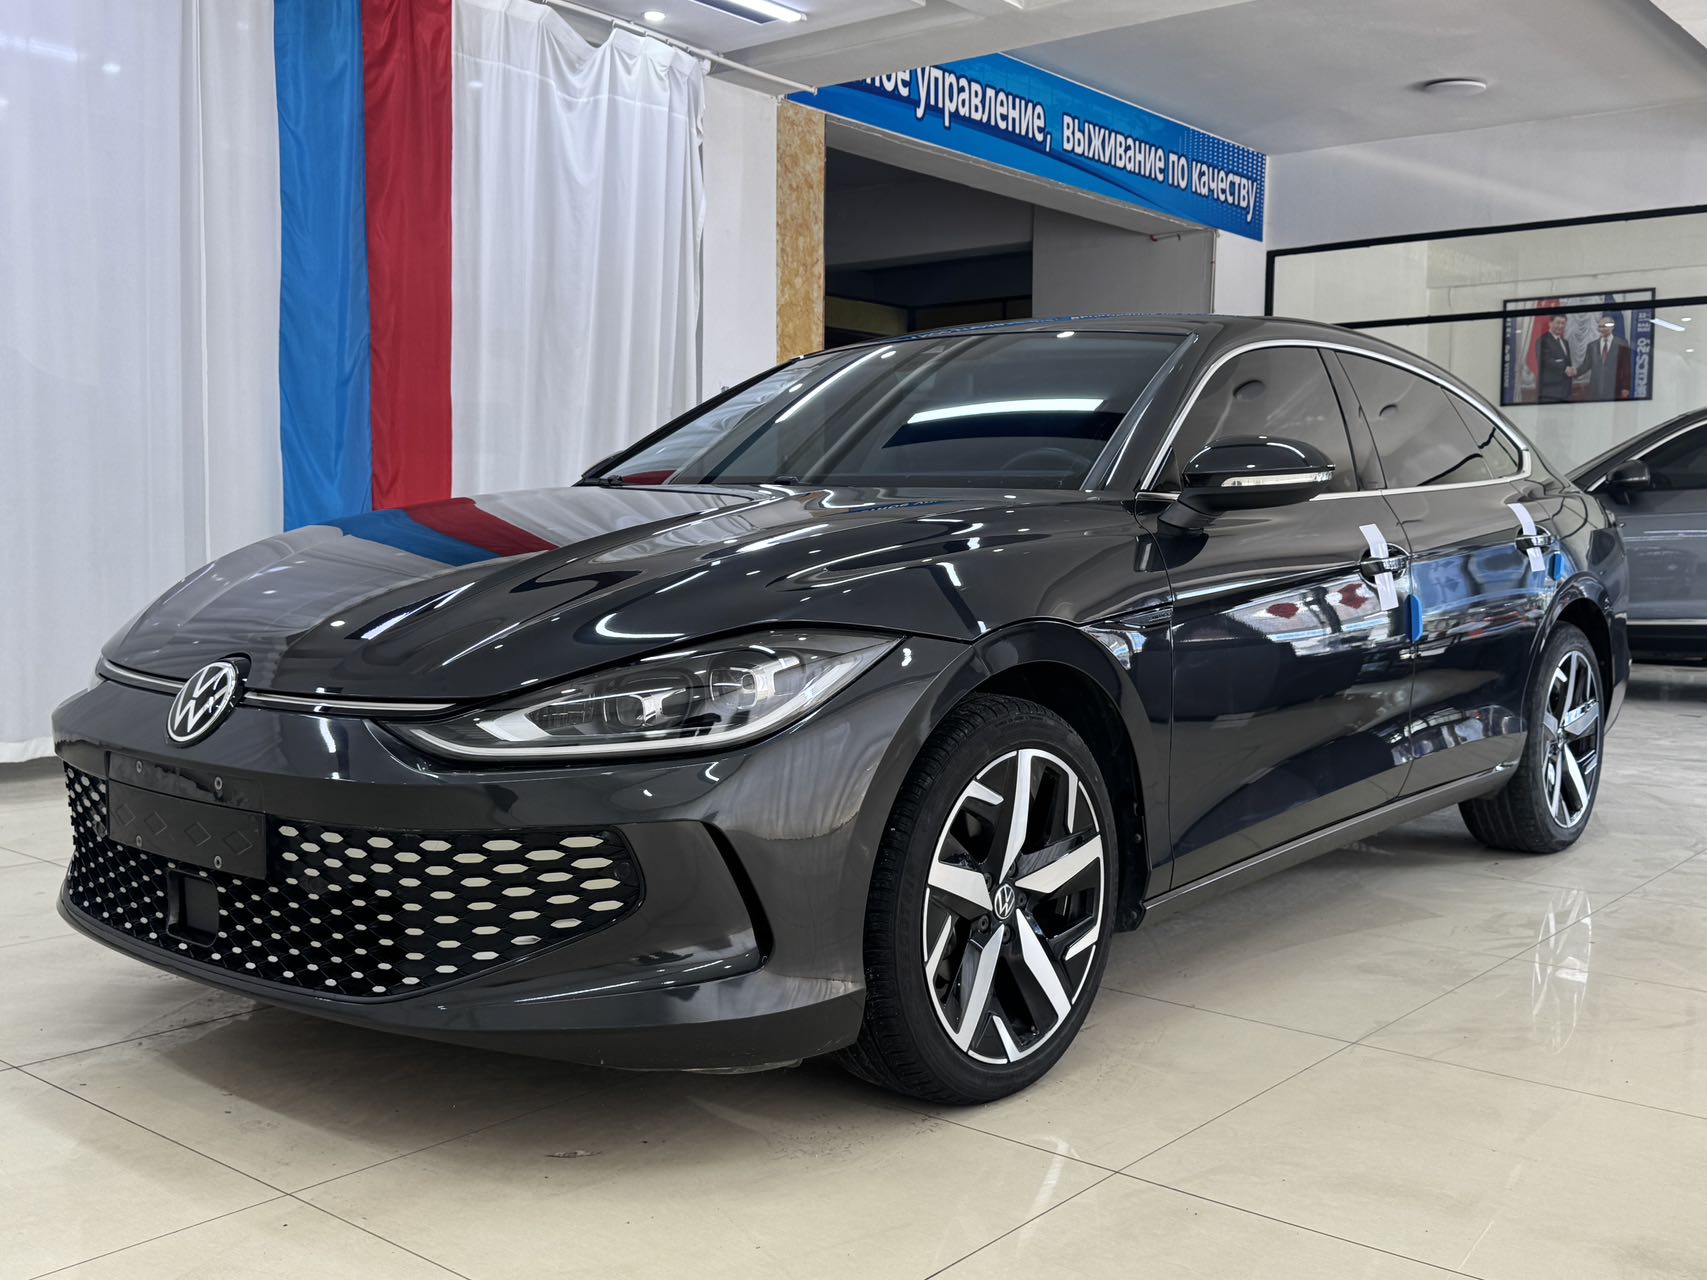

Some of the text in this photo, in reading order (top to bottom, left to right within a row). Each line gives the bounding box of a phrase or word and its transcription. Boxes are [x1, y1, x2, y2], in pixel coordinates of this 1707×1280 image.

[916, 65, 1052, 152] управление,
[1063, 115, 1165, 182] выживание
[1169, 152, 1188, 189] по
[1192, 161, 1257, 222] качеству
